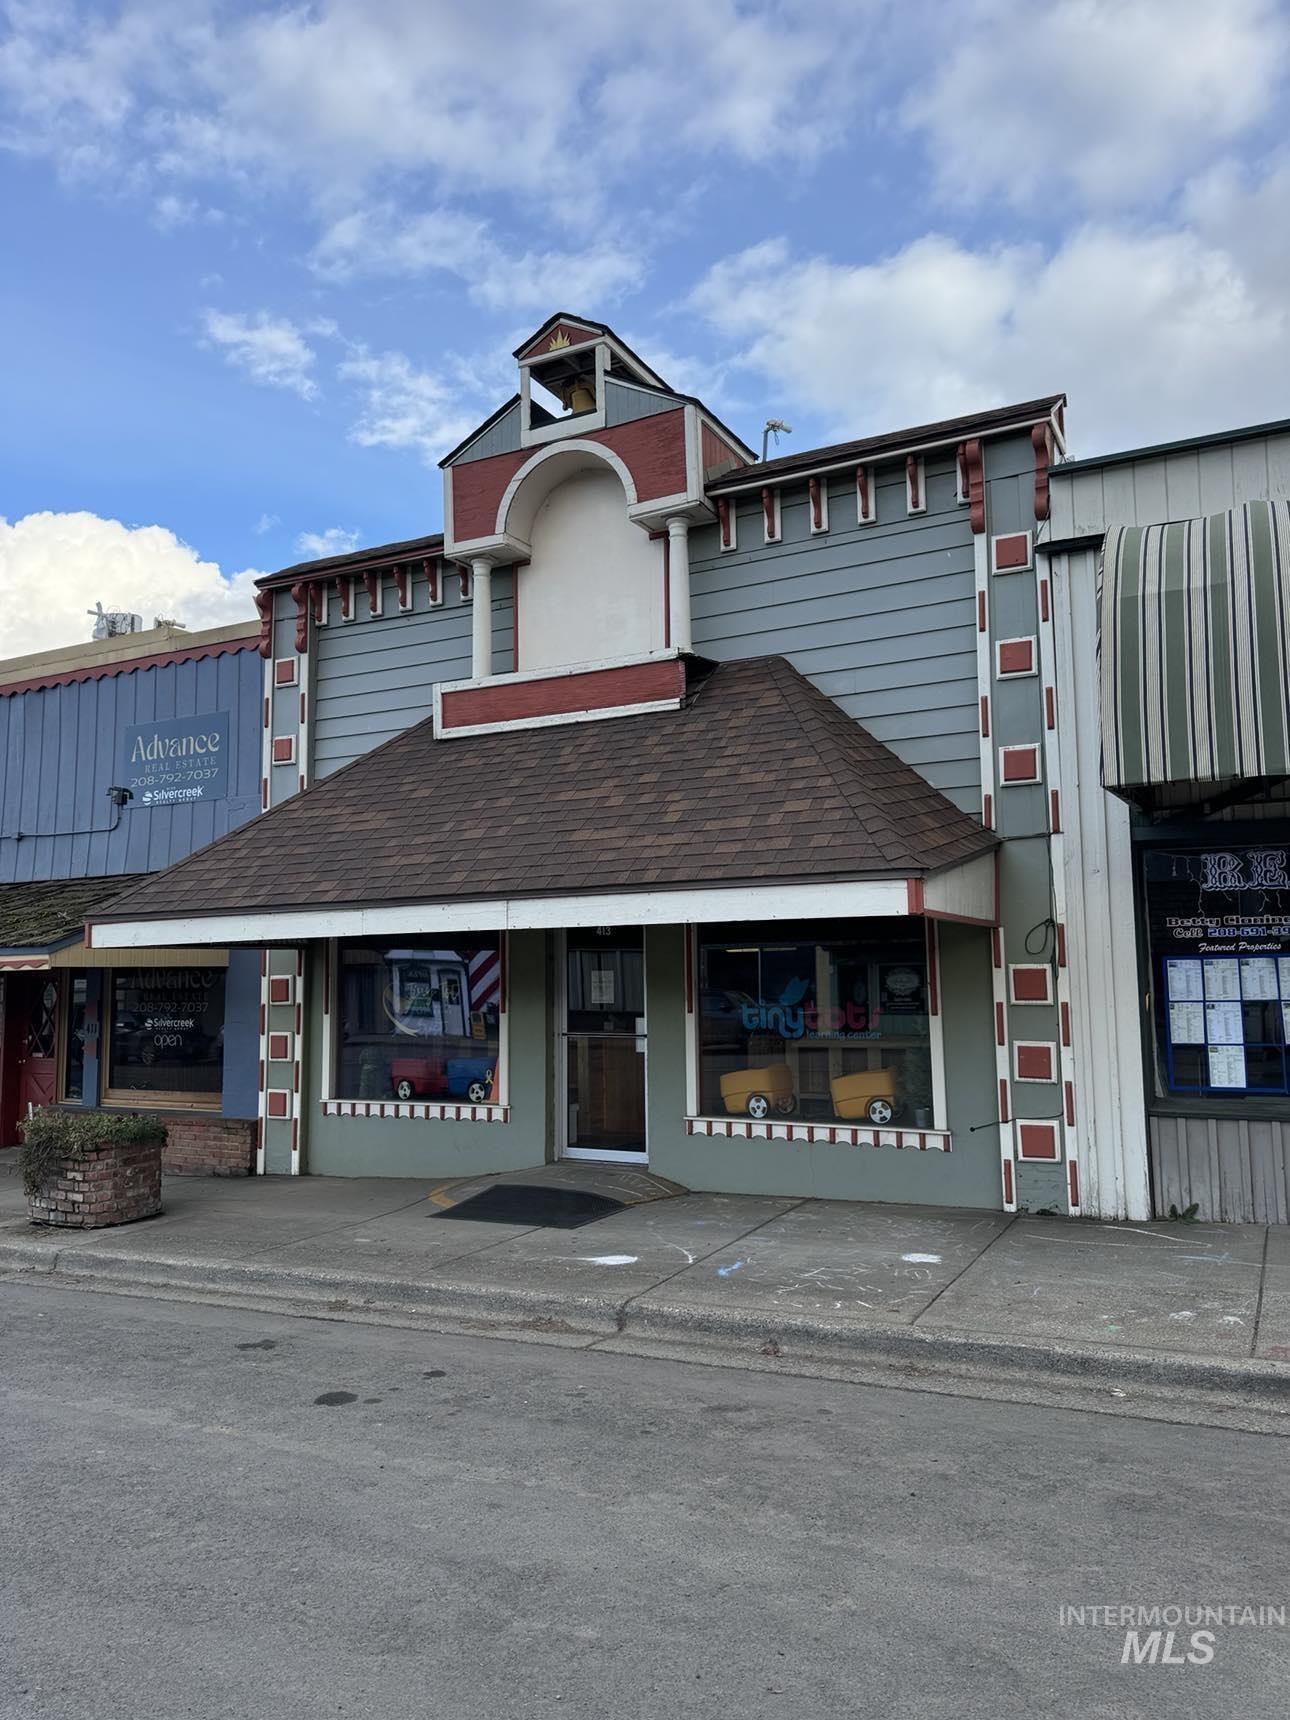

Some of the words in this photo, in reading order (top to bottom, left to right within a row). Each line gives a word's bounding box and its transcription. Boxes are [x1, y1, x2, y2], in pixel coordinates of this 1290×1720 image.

[131, 733, 220, 763] Advance
[145, 762, 171, 774] REAL
[175, 756, 217, 770] ESTATE
[130, 768, 219, 788] 208-792-7037
[153, 785, 205, 801] Silvercreek
[1200, 850, 1290, 892] RE
[1166, 917, 1222, 928] Betty
[596, 926, 611, 936] 413
[1198, 942, 1236, 953] Featured
[1238, 941, 1283, 952] Properties
[134, 1001, 209, 1013] 208-792-7037
[153, 1017, 194, 1028] Silvercreek
[153, 1034, 183, 1048] open
[806, 1030, 846, 1041] learning
[847, 1030, 882, 1040] center
